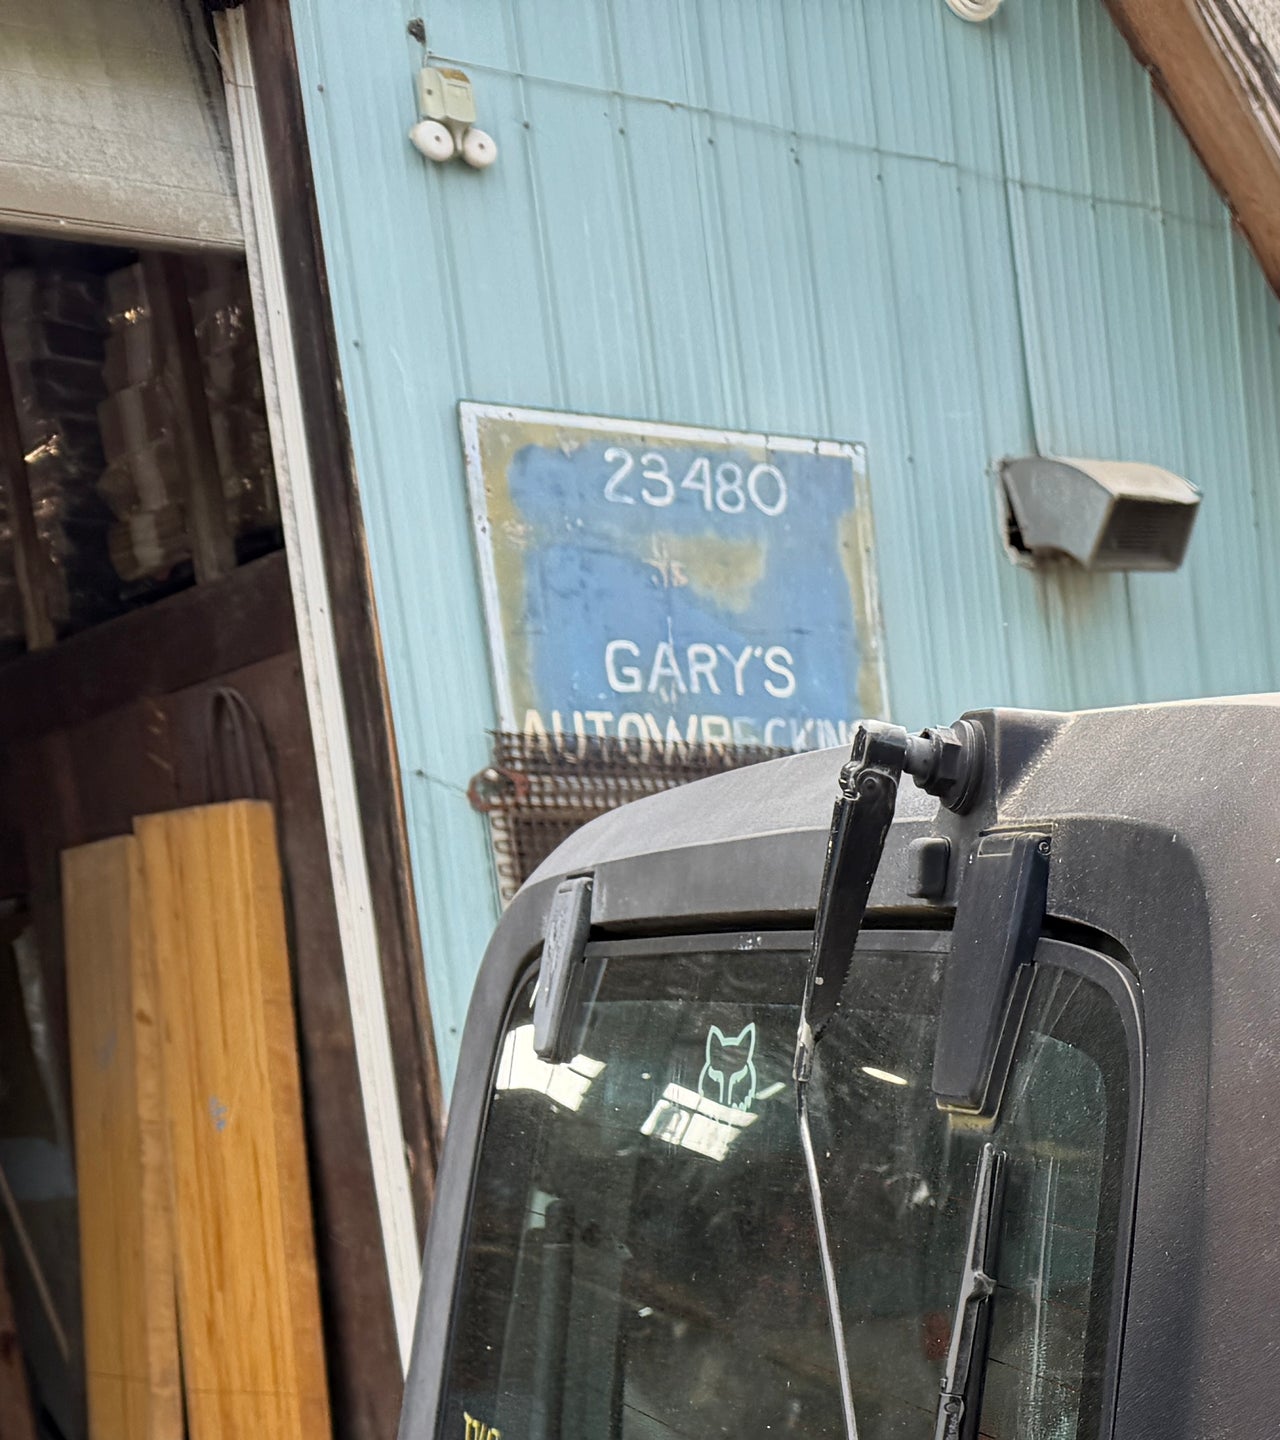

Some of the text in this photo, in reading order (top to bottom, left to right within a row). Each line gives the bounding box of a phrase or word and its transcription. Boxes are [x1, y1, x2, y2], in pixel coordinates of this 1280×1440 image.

[603, 446, 788, 517] 23480
[604, 638, 797, 699] GARY'S
[522, 708, 859, 765] AUTOWRECKIN
